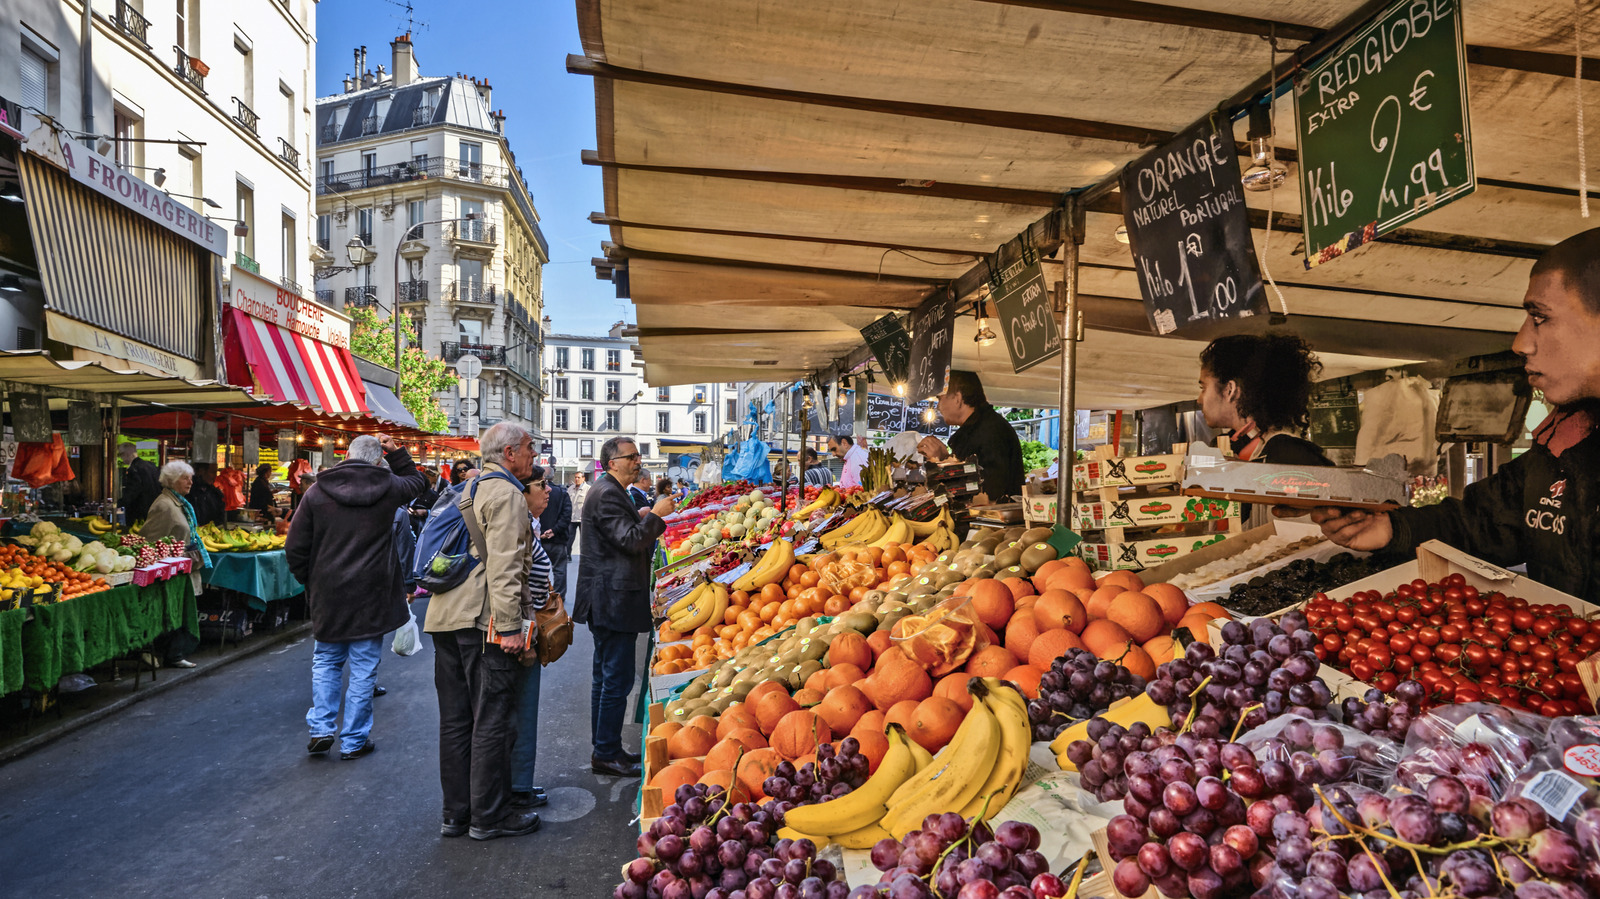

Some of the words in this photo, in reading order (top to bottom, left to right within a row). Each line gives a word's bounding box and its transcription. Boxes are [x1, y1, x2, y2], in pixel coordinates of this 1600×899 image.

[1409, 70, 1435, 111] €
[1308, 91, 1360, 135] EXTRA
[1138, 134, 1228, 203] ORANGE
[88, 155, 215, 244] FROMAGERIE
[1133, 190, 1186, 229] NATUREL
[1180, 184, 1242, 228] PORTUGAL
[1308, 161, 1354, 226] Kilo
[1140, 255, 1174, 301] Kilo
[236, 288, 278, 324] Charcuterie
[285, 311, 320, 339] Hamouche
[327, 325, 348, 350] Volailles
[276, 287, 324, 324] BOUCHERIE
[94, 330, 112, 352] LA
[123, 340, 179, 373] FROMAGERIE
[1011, 317, 1026, 360] 6
